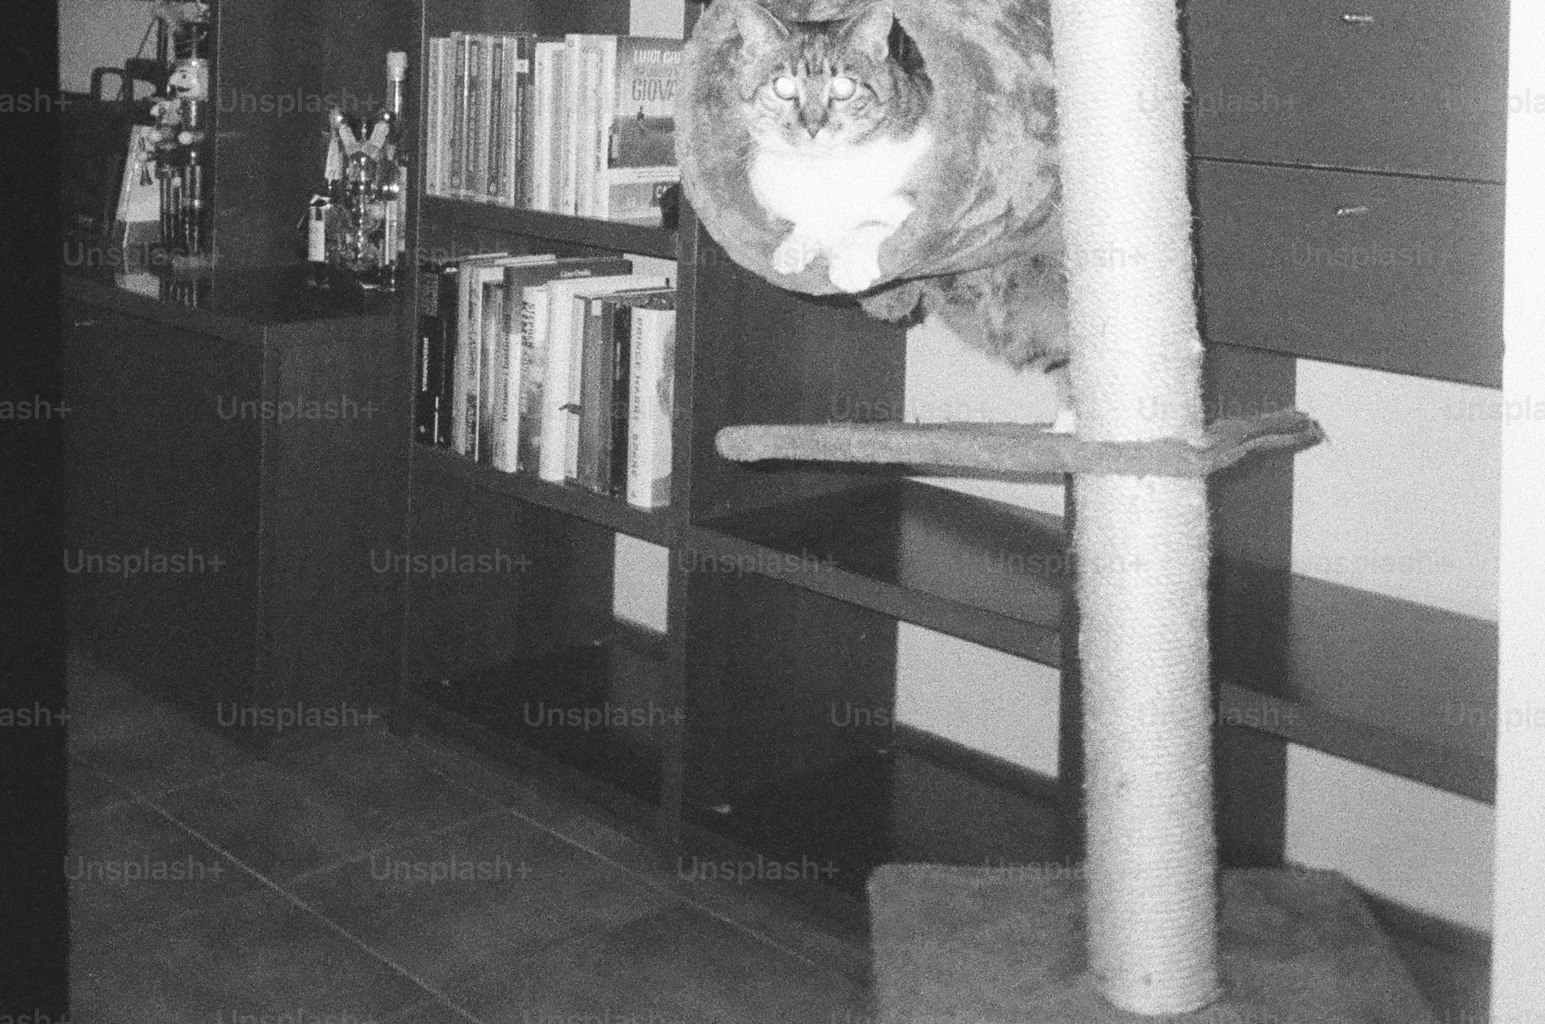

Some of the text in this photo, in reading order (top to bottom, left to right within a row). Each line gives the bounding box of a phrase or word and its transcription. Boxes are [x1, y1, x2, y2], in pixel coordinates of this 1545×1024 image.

[631, 78, 677, 102] GIOVA
[630, 316, 644, 479] PRINCE HARRY SPARE
